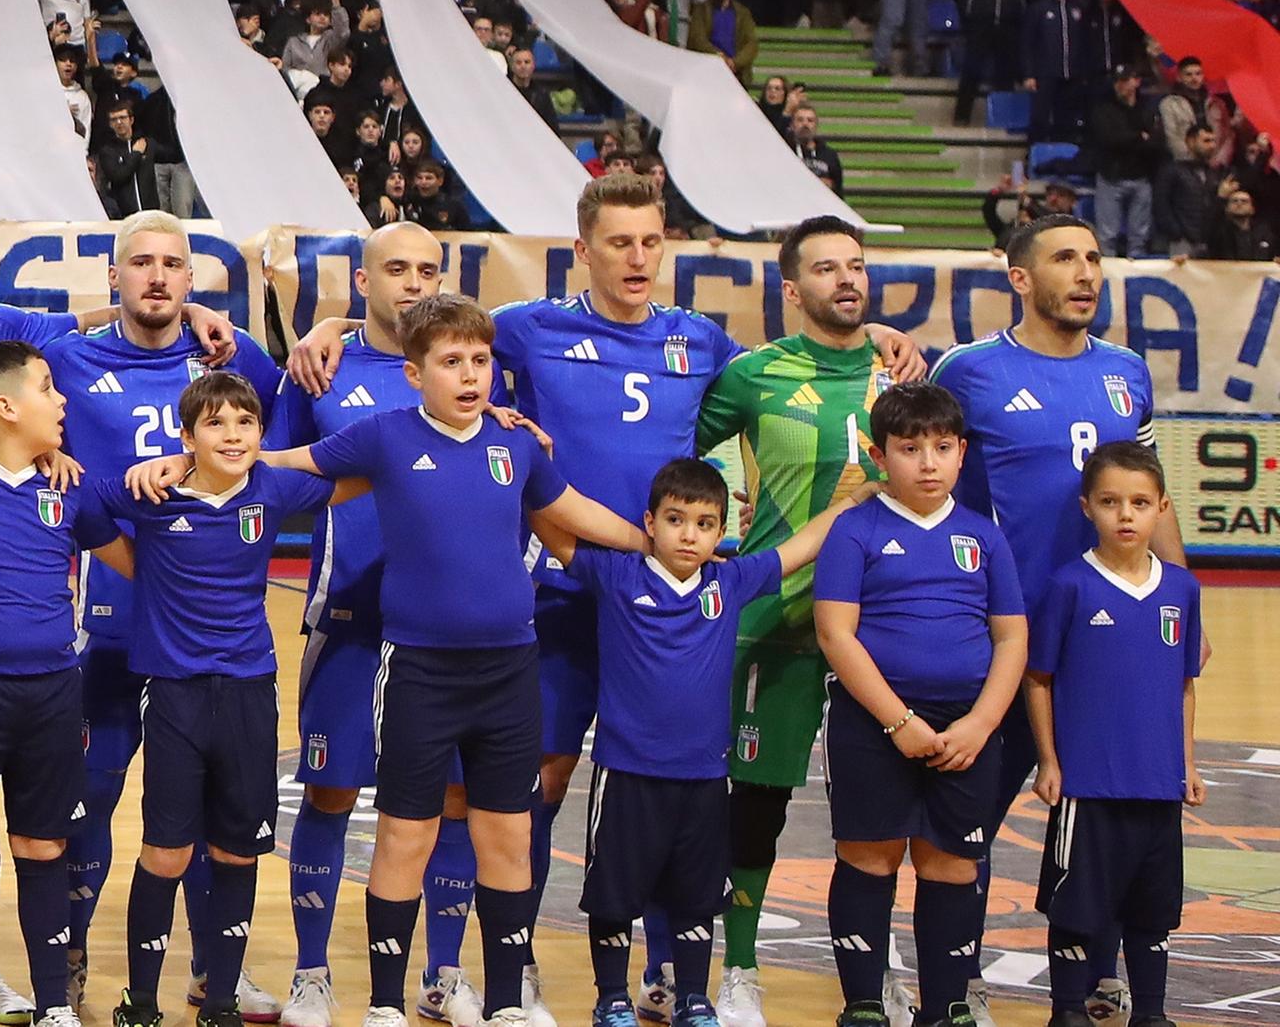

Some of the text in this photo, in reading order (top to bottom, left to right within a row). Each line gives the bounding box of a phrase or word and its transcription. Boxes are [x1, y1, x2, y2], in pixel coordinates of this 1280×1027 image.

[622, 372, 650, 422] 5
[132, 405, 186, 457] 24
[1070, 422, 1097, 471] 8
[1198, 433, 1257, 490] 9
[239, 507, 261, 517] ITALIA
[954, 537, 978, 547] ITALIA
